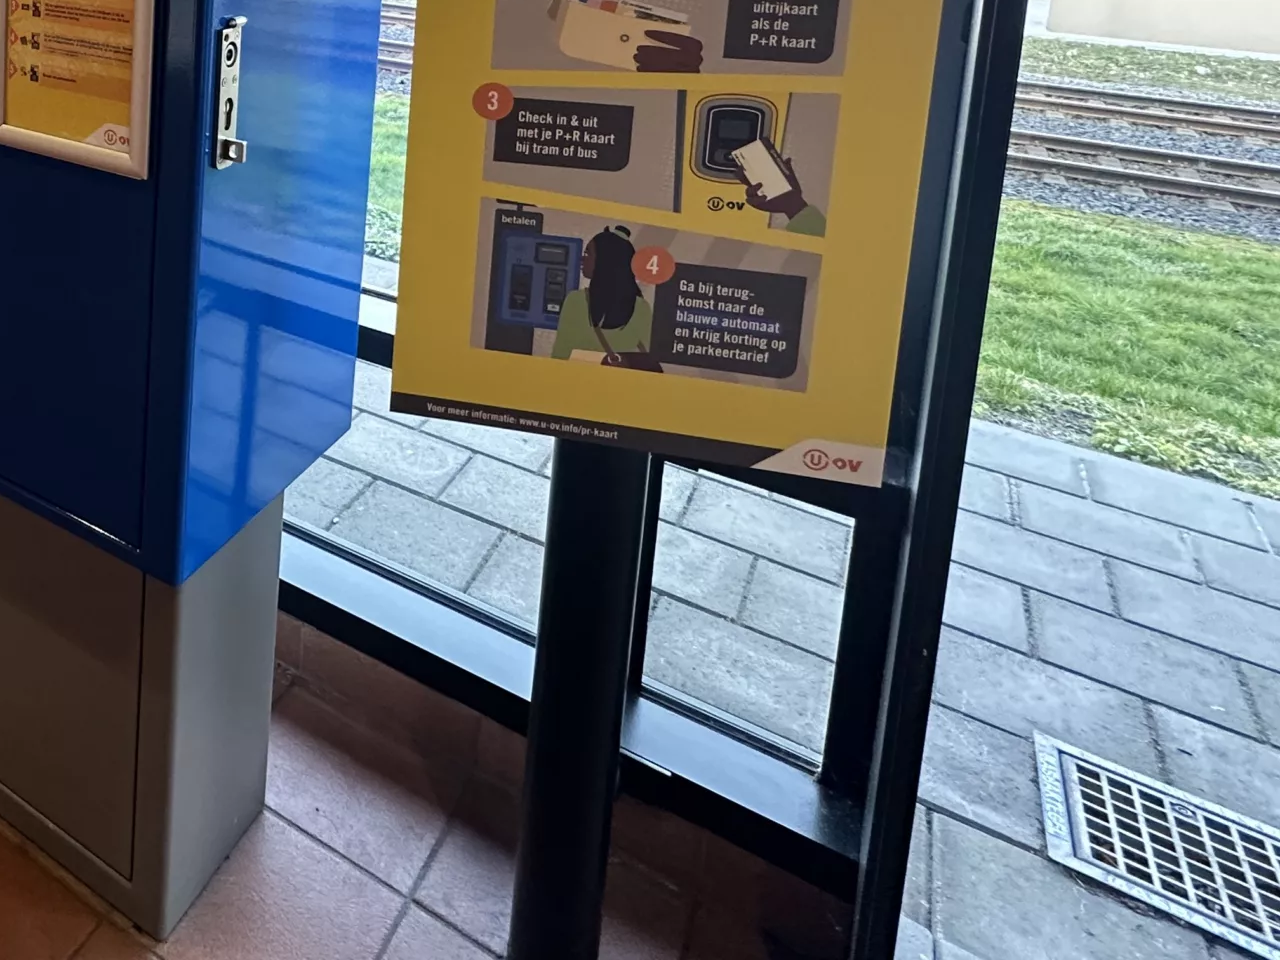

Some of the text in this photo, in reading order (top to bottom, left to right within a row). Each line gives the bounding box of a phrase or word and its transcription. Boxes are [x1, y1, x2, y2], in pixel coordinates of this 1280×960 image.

[12, 1, 16, 9] 3
[753, 1, 818, 16] uitrijkaart
[751, 18, 789, 30] als de
[750, 34, 816, 49] P+R kaart
[487, 91, 499, 110] 3
[518, 111, 598, 128] Check in & uit
[517, 128, 615, 145] met je P+R kaart
[516, 142, 598, 159] bij tram of bus
[501, 215, 536, 226] betalen
[646, 255, 659, 275] 4
[679, 280, 755, 301] Ga bij terug-
[678, 296, 764, 316] komst naar de
[676, 310, 780, 334] blauwe automaat
[675, 327, 786, 352] en krijg korting op
[672, 341, 769, 363] je parkeertarief
[427, 402, 619, 440] Voor meer informatie: www.u-ov.info/pr-kaart
